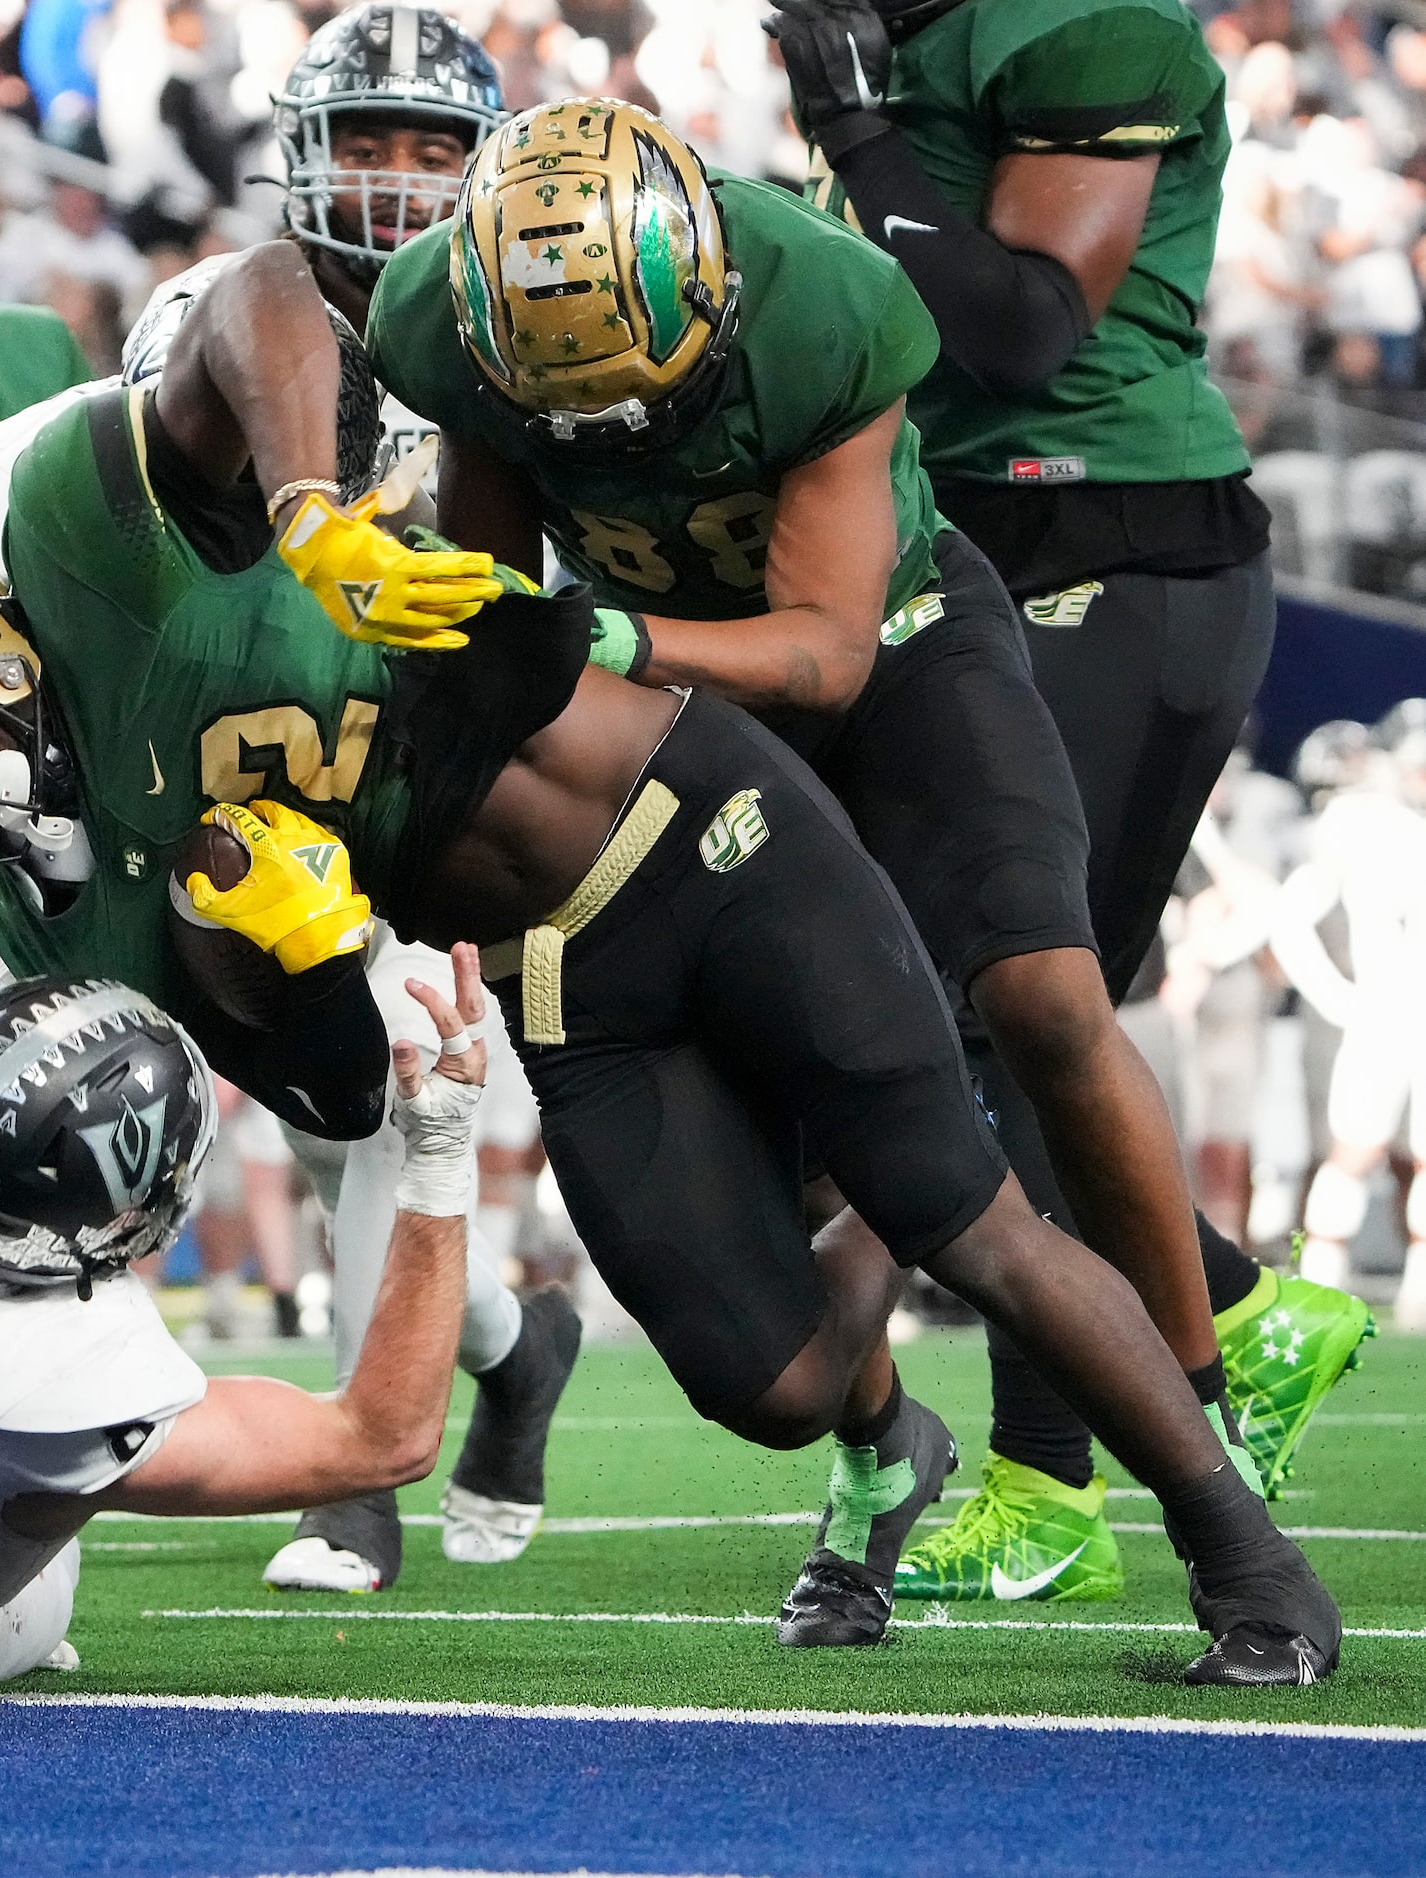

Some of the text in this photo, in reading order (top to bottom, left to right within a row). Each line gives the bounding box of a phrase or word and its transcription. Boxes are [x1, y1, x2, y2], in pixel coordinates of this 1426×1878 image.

[1044, 463, 1074, 477] 3XL
[571, 492, 776, 593] 88
[200, 698, 380, 804] 2
